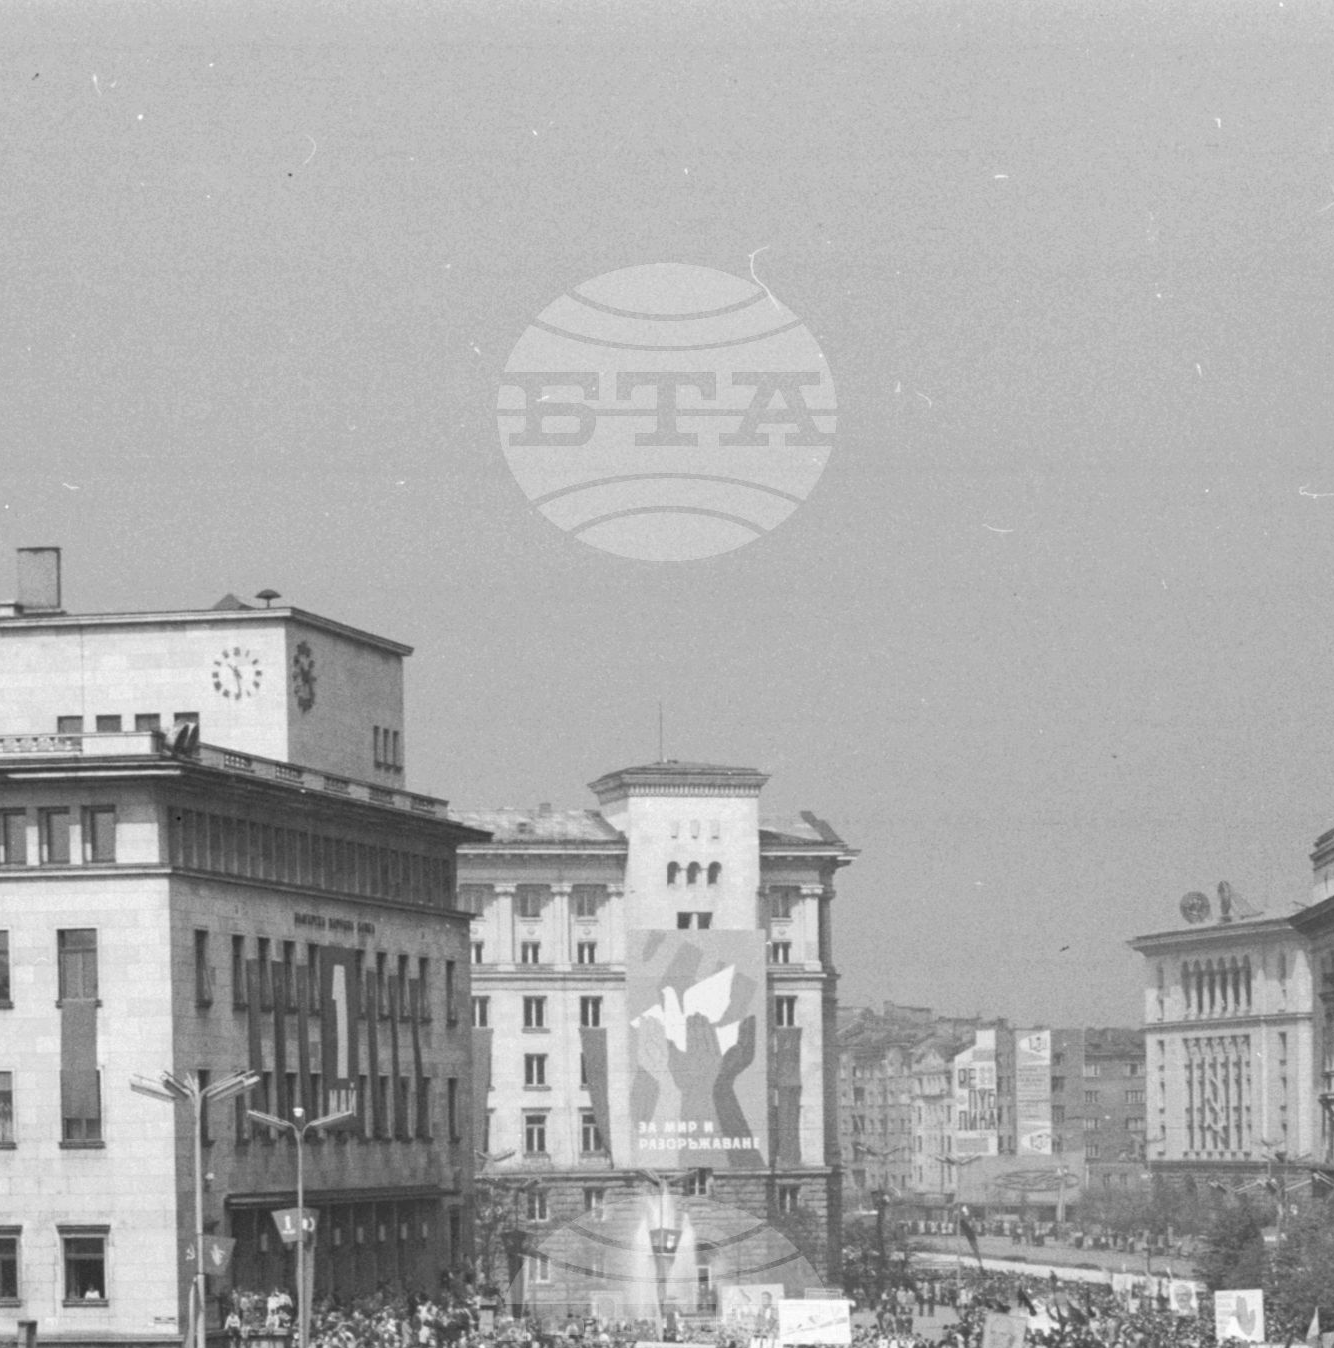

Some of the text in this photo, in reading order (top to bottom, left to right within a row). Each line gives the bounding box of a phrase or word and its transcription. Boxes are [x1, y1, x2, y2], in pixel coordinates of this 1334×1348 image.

[638, 1121, 713, 1133] ЗА МИР И
[639, 1137, 760, 1149] РАЗОРЪЖАВАНЕ
